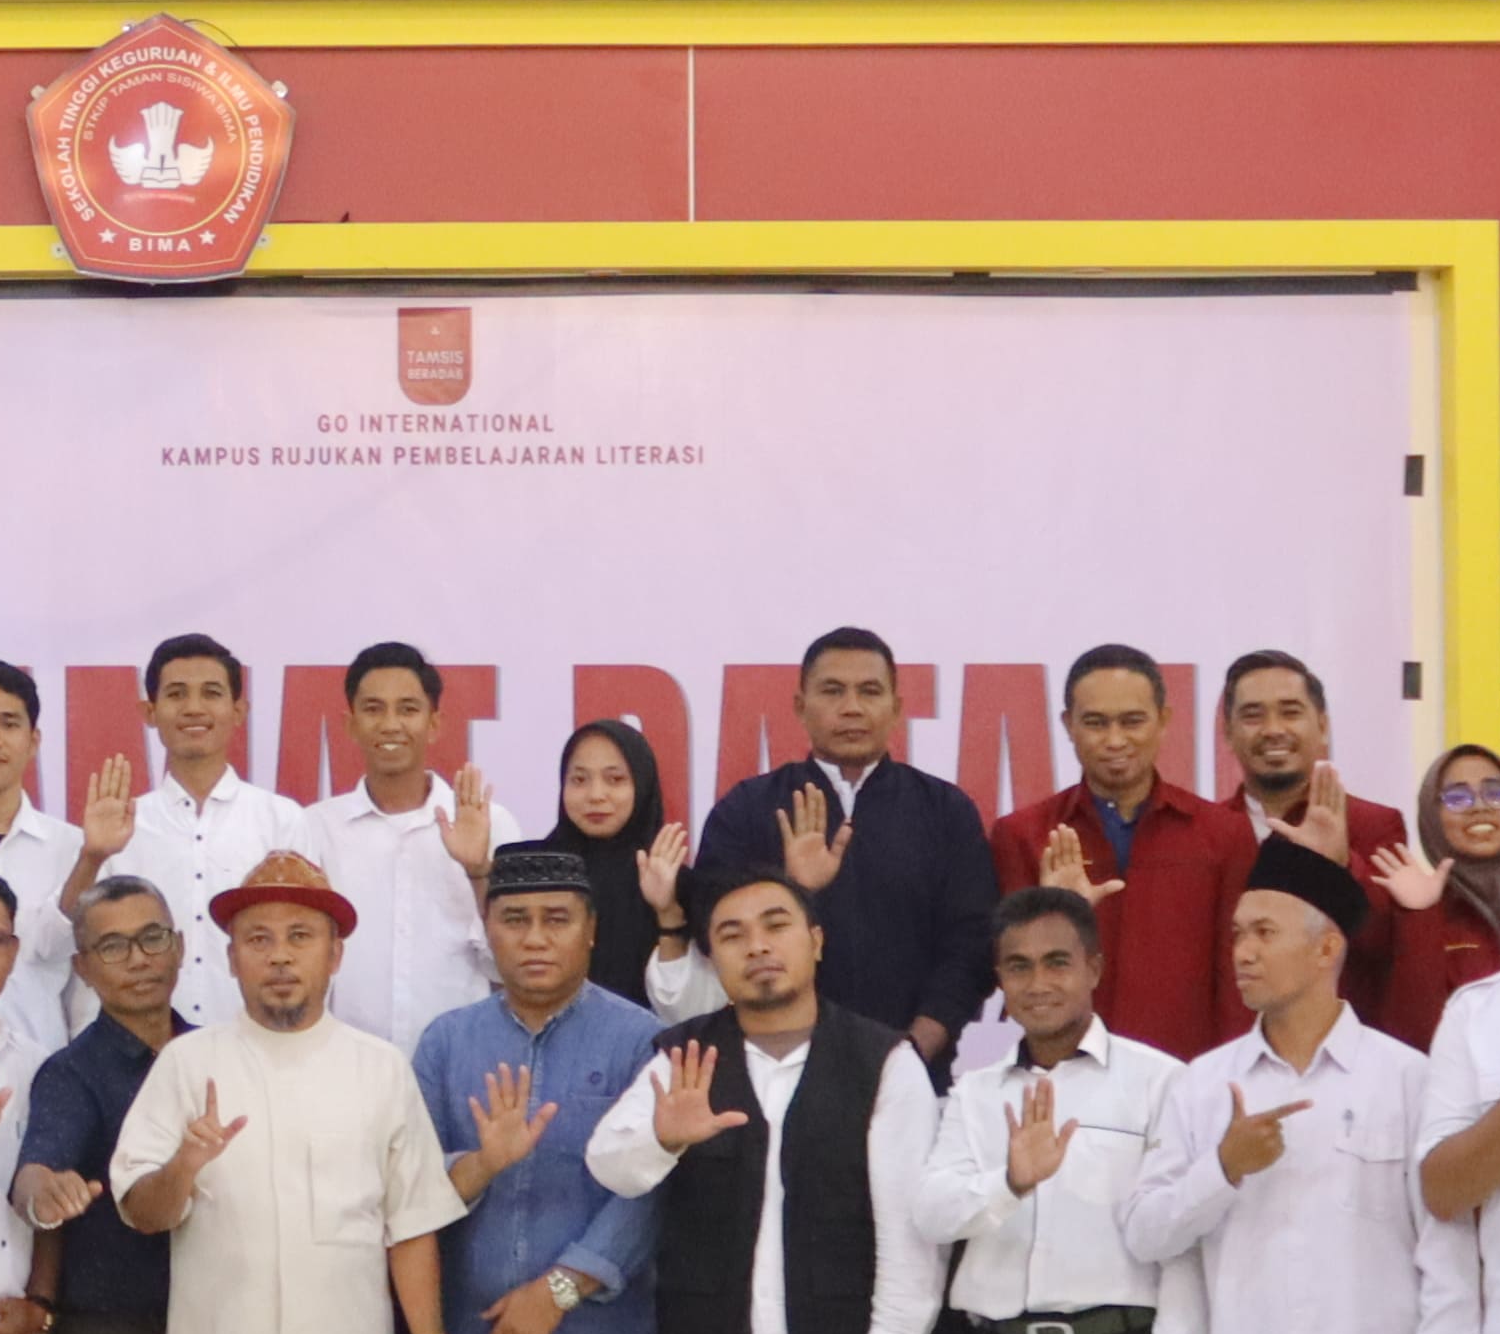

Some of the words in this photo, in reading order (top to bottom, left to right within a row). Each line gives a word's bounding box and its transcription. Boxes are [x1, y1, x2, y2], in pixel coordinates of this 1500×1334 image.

[98, 47, 202, 78] KEGURUAN
[204, 62, 217, 76] &
[59, 74, 99, 130] TINGGI
[218, 71, 253, 111] ILMU
[109, 73, 162, 97] TAMAN
[216, 104, 237, 143] BIMA
[57, 137, 95, 222] SEKOLAH
[224, 115, 263, 224] PENDIDIKAN
[128, 237, 191, 252] BIMA
[407, 350, 463, 364] TAMSIS
[317, 415, 348, 433] GO
[360, 414, 554, 433] INTERNATIONAL
[161, 447, 260, 466] KAMPUS
[272, 447, 382, 465] RUJUKAN
[394, 446, 585, 465] PEMBELAJARAN
[597, 445, 704, 465] LITERASI
